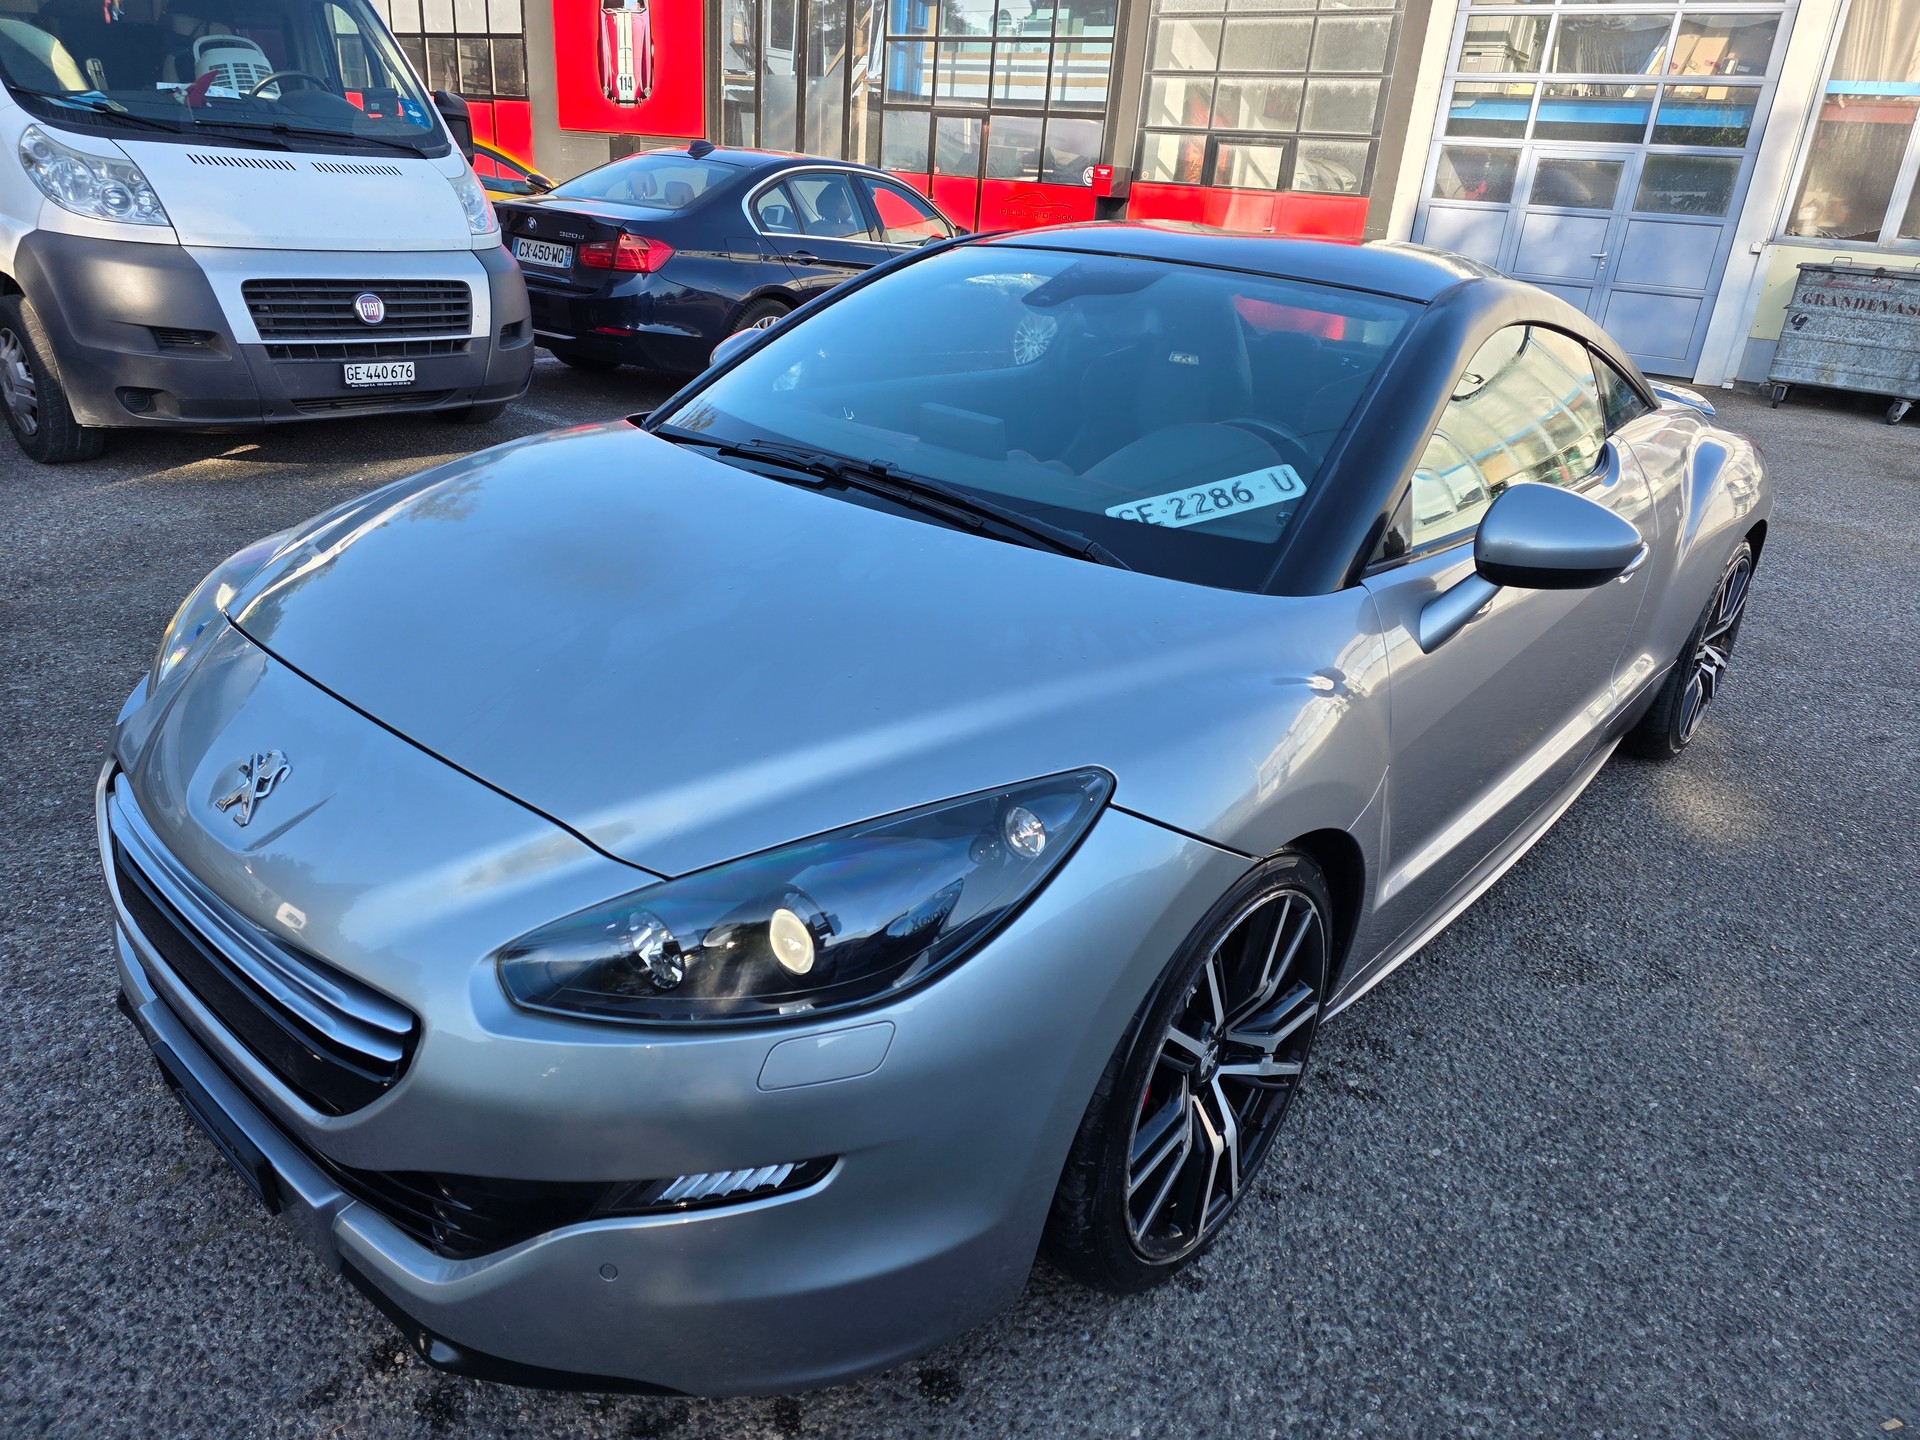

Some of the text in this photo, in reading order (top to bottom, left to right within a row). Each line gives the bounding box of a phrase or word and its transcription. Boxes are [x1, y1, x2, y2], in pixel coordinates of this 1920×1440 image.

[619, 75, 633, 91] 114
[559, 231, 585, 240] 320d
[361, 302, 379, 316] FIAT
[1801, 292, 1920, 316] GRANDEVAS
